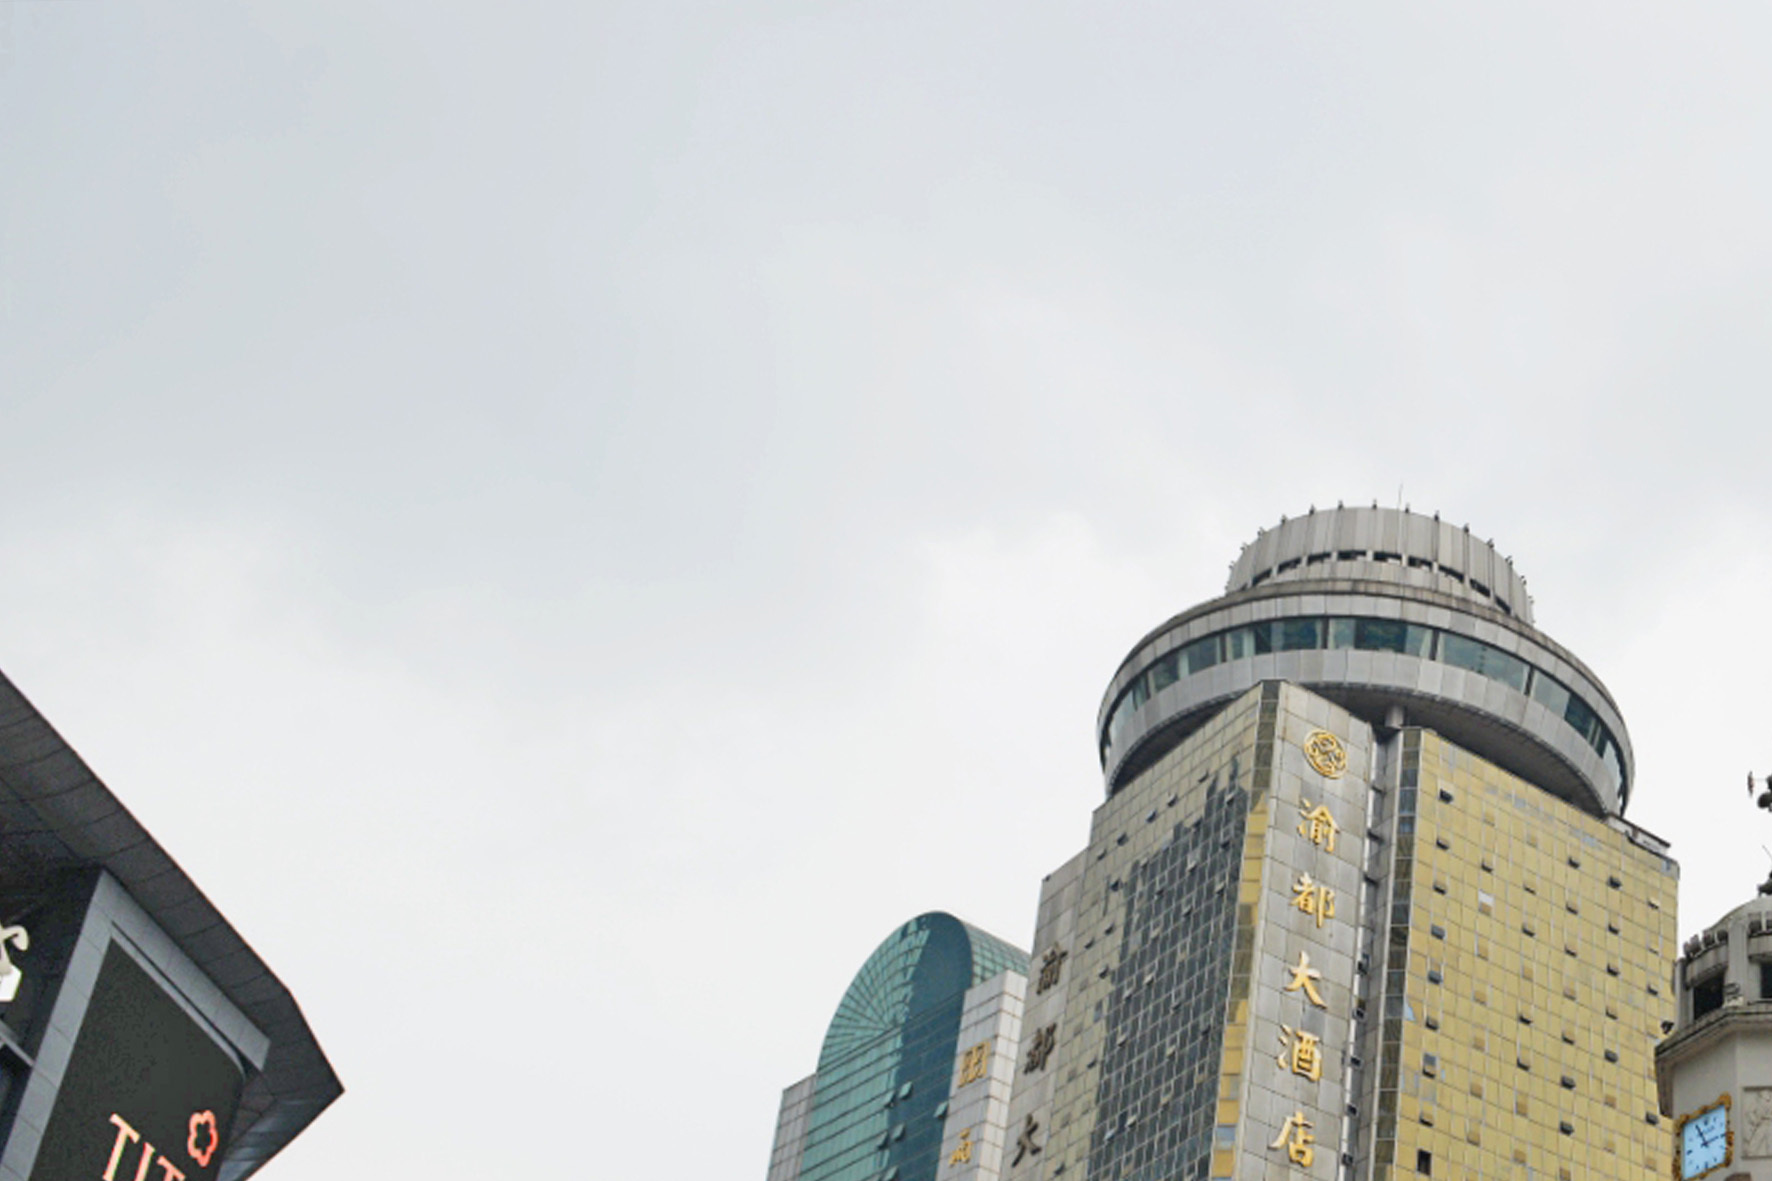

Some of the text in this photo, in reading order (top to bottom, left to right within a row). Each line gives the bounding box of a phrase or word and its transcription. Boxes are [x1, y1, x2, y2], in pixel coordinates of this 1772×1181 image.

[1267, 798, 1341, 1168] 渝都大酒店
